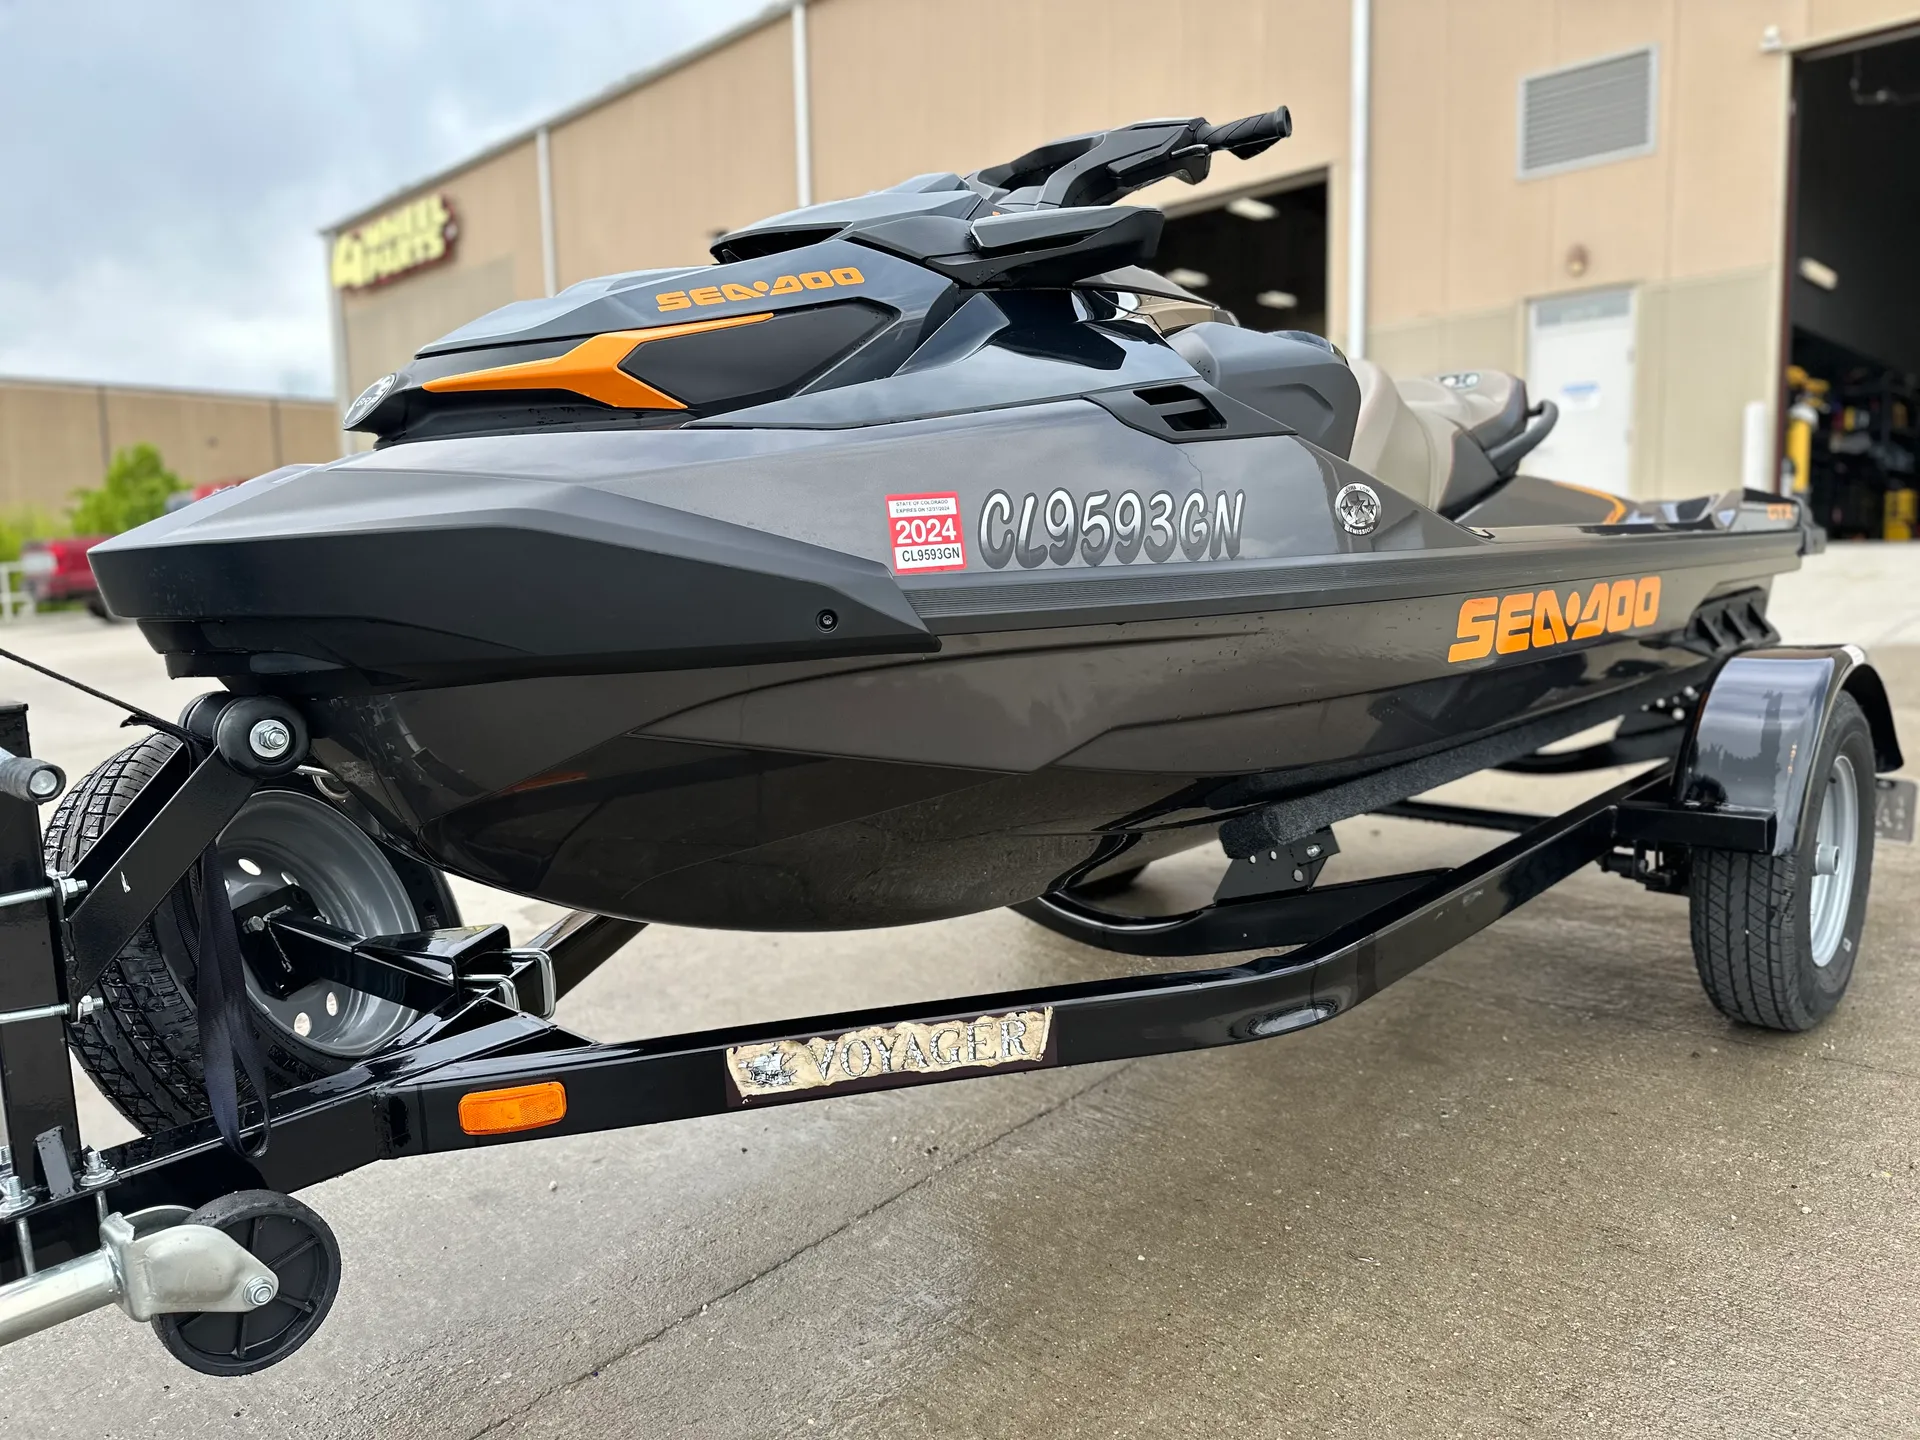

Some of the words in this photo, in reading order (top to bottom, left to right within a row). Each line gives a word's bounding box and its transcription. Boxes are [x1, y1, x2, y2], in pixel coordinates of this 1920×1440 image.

[331, 231, 364, 287] 4
[895, 517, 957, 545] 2024
[902, 547, 960, 562] CL9593GN
[978, 487, 1246, 570] CL9593GN
[806, 1018, 1031, 1081] VOYAGER
